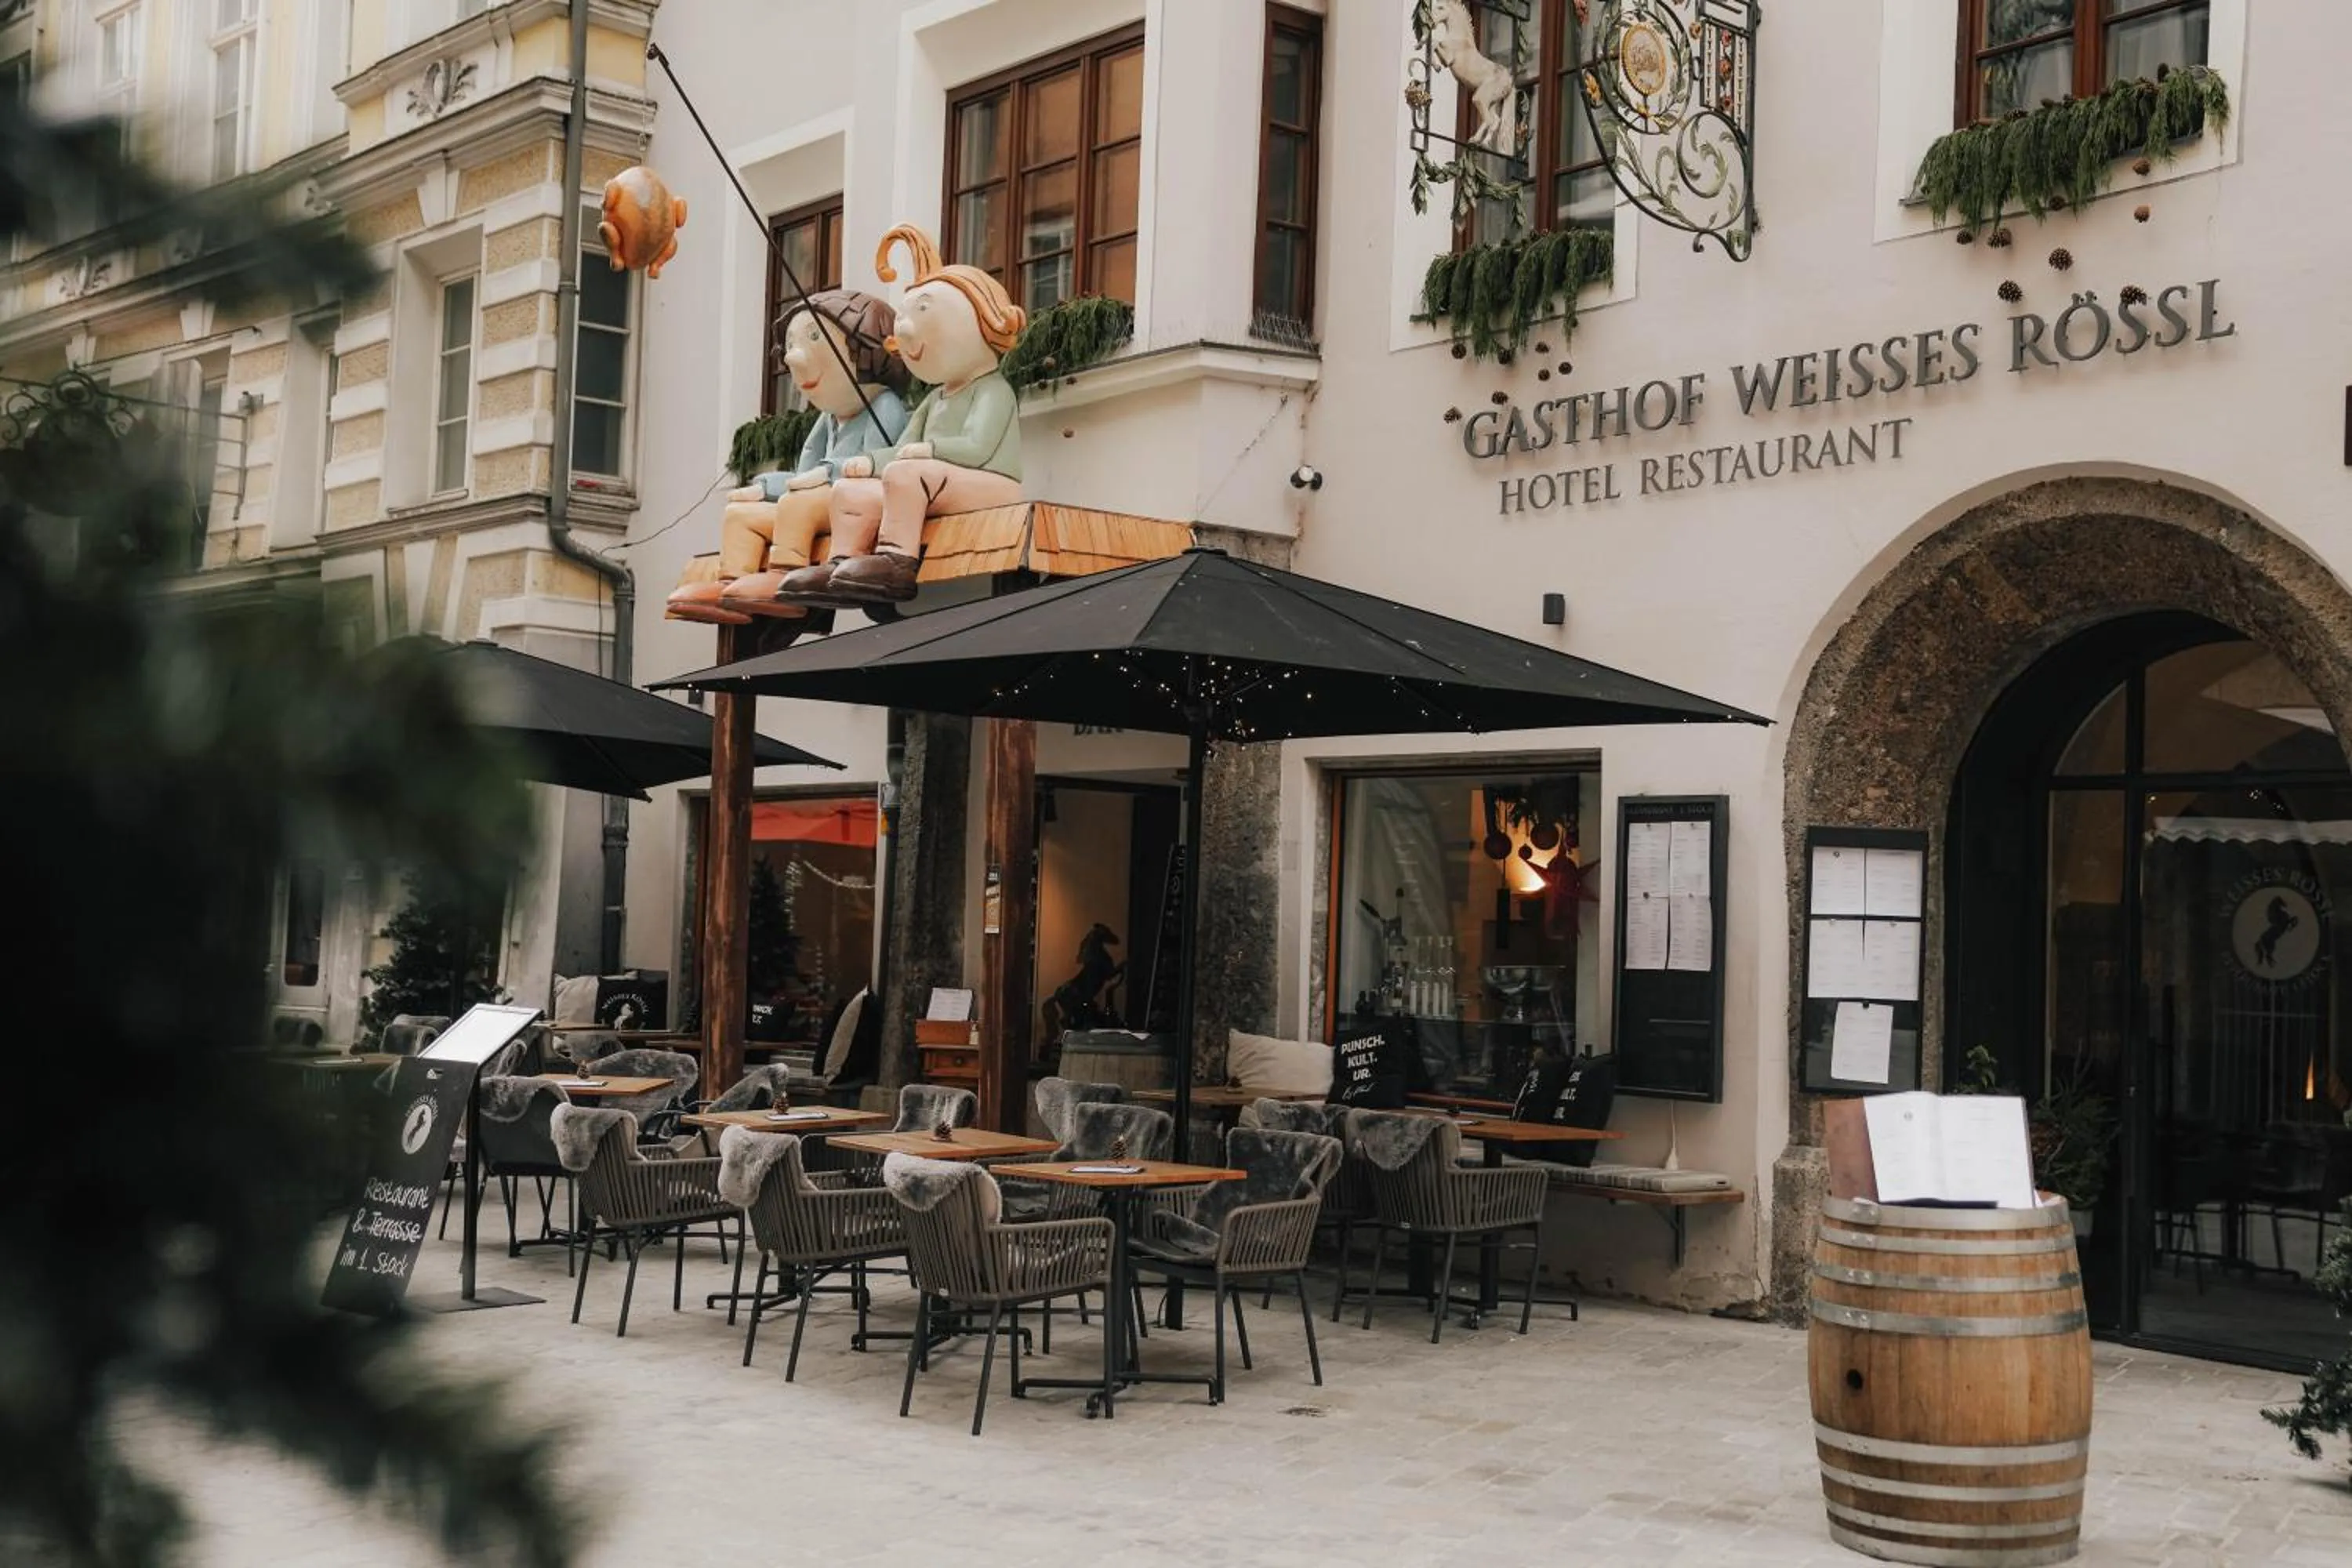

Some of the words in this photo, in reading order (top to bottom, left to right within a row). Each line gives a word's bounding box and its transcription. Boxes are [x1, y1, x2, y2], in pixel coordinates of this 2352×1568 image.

[1464, 372, 1705, 459] GASTHOF
[1730, 322, 1982, 416] WEISSES
[2006, 278, 2236, 372] RÖSSL
[1498, 463, 1621, 515] HOTEL
[1639, 417, 1914, 495] RESTAURANT
[1341, 1034, 1385, 1054] PUNSCH.
[1347, 1051, 1378, 1068] KULT.
[1352, 1067, 1371, 1081] UR.
[363, 1177, 430, 1209] Restaurant
[369, 1211, 423, 1243] Terrasse
